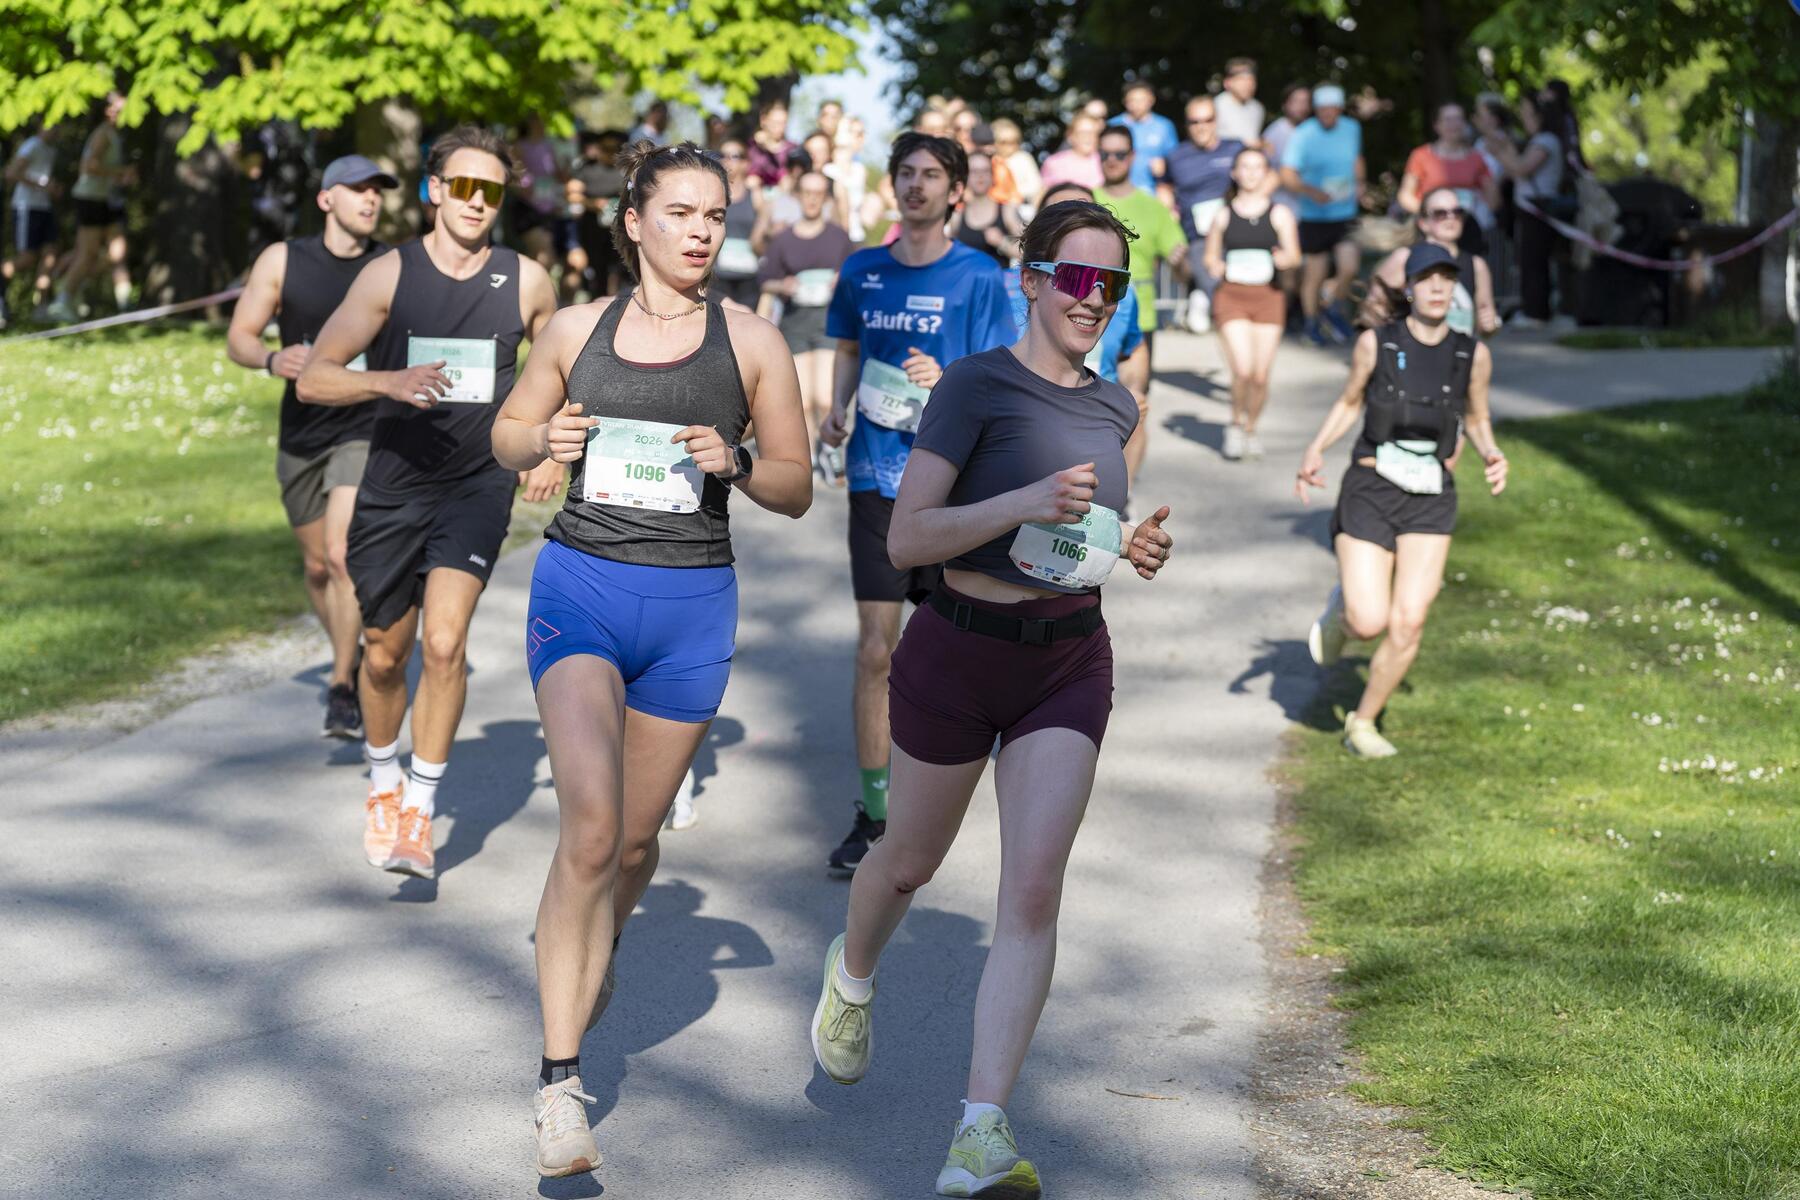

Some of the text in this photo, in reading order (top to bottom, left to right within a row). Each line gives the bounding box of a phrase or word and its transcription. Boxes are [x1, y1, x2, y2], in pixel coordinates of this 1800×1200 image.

[634, 434, 663, 446] 2026
[624, 463, 666, 483] 1096
[1052, 538, 1088, 562] 1066
